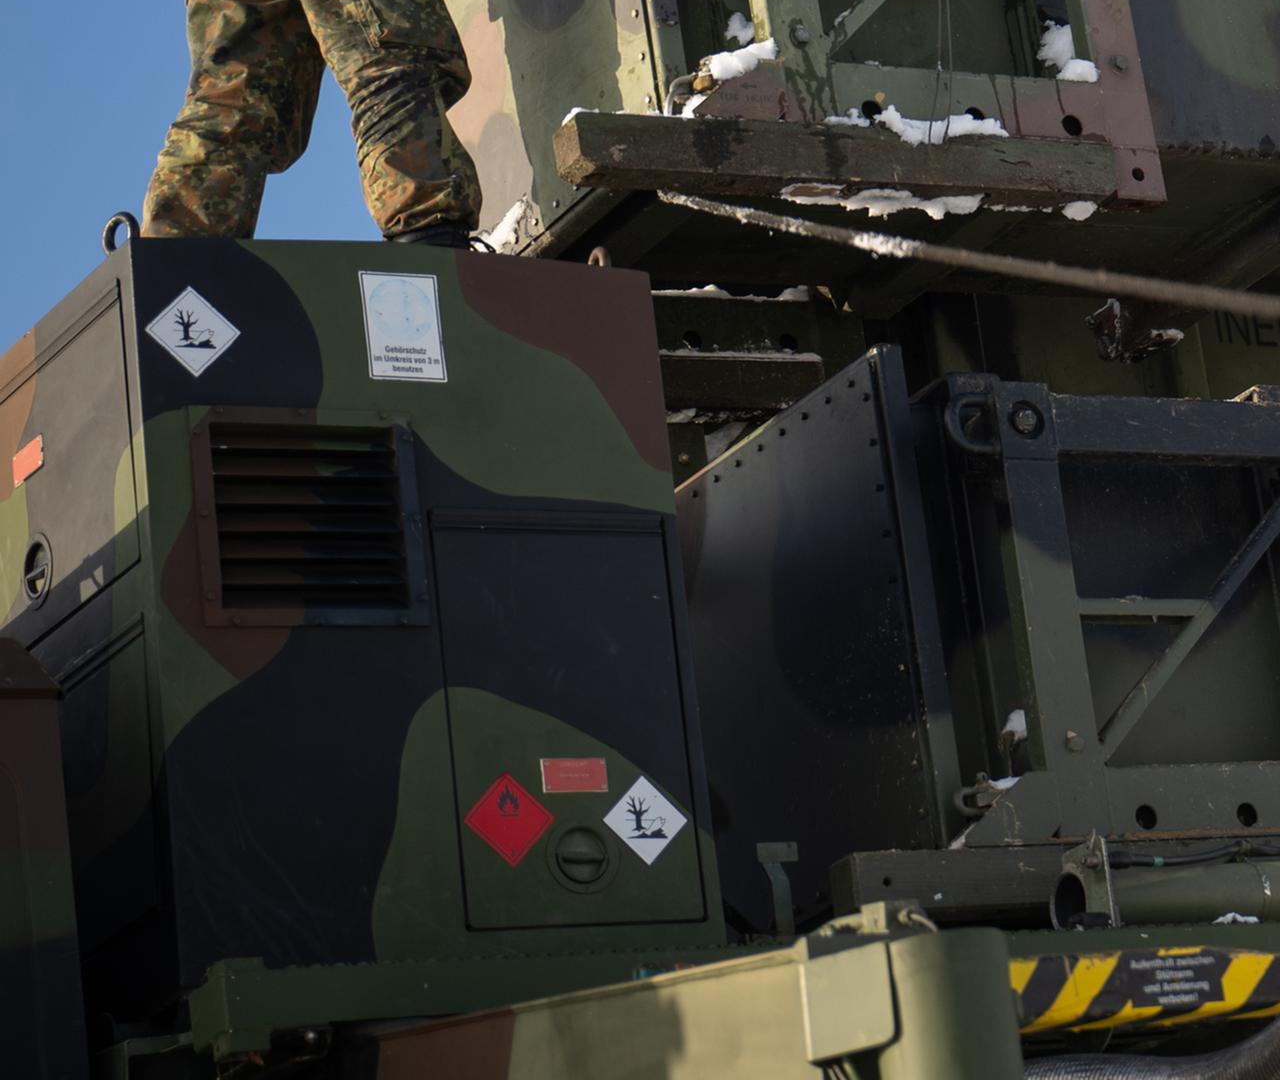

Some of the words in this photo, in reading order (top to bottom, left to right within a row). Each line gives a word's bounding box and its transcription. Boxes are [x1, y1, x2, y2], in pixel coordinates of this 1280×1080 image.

[384, 345, 427, 355] Gehörschutz
[373, 354, 383, 362] im
[384, 354, 413, 363] Umkreis
[392, 365, 424, 373] benutzen
[1176, 956, 1215, 967] zwischen
[1143, 983, 1161, 994] und
